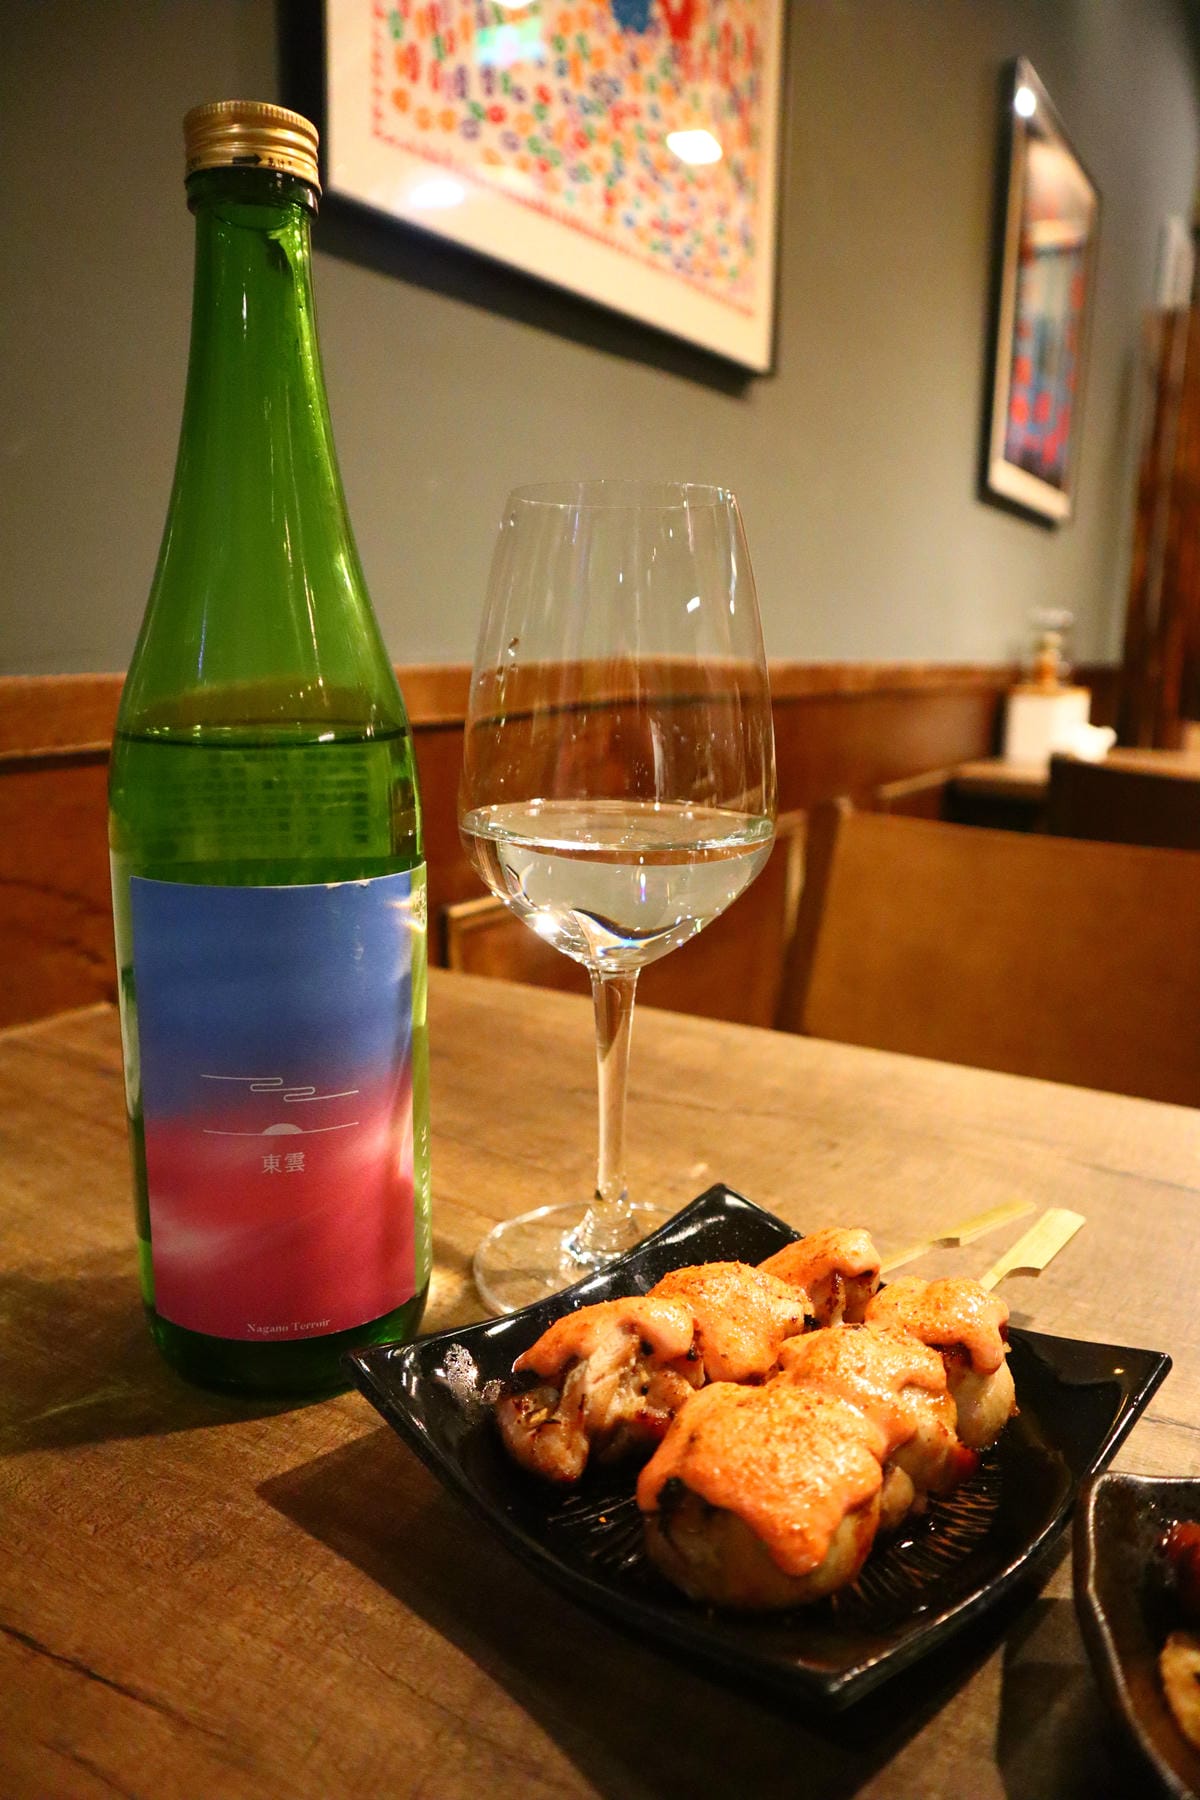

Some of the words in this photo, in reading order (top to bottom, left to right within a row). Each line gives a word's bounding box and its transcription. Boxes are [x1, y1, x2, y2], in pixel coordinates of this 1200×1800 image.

[261, 1152, 305, 1174] 東雲
[247, 1323, 289, 1335] Nagano
[291, 1319, 330, 1331] Terroir
